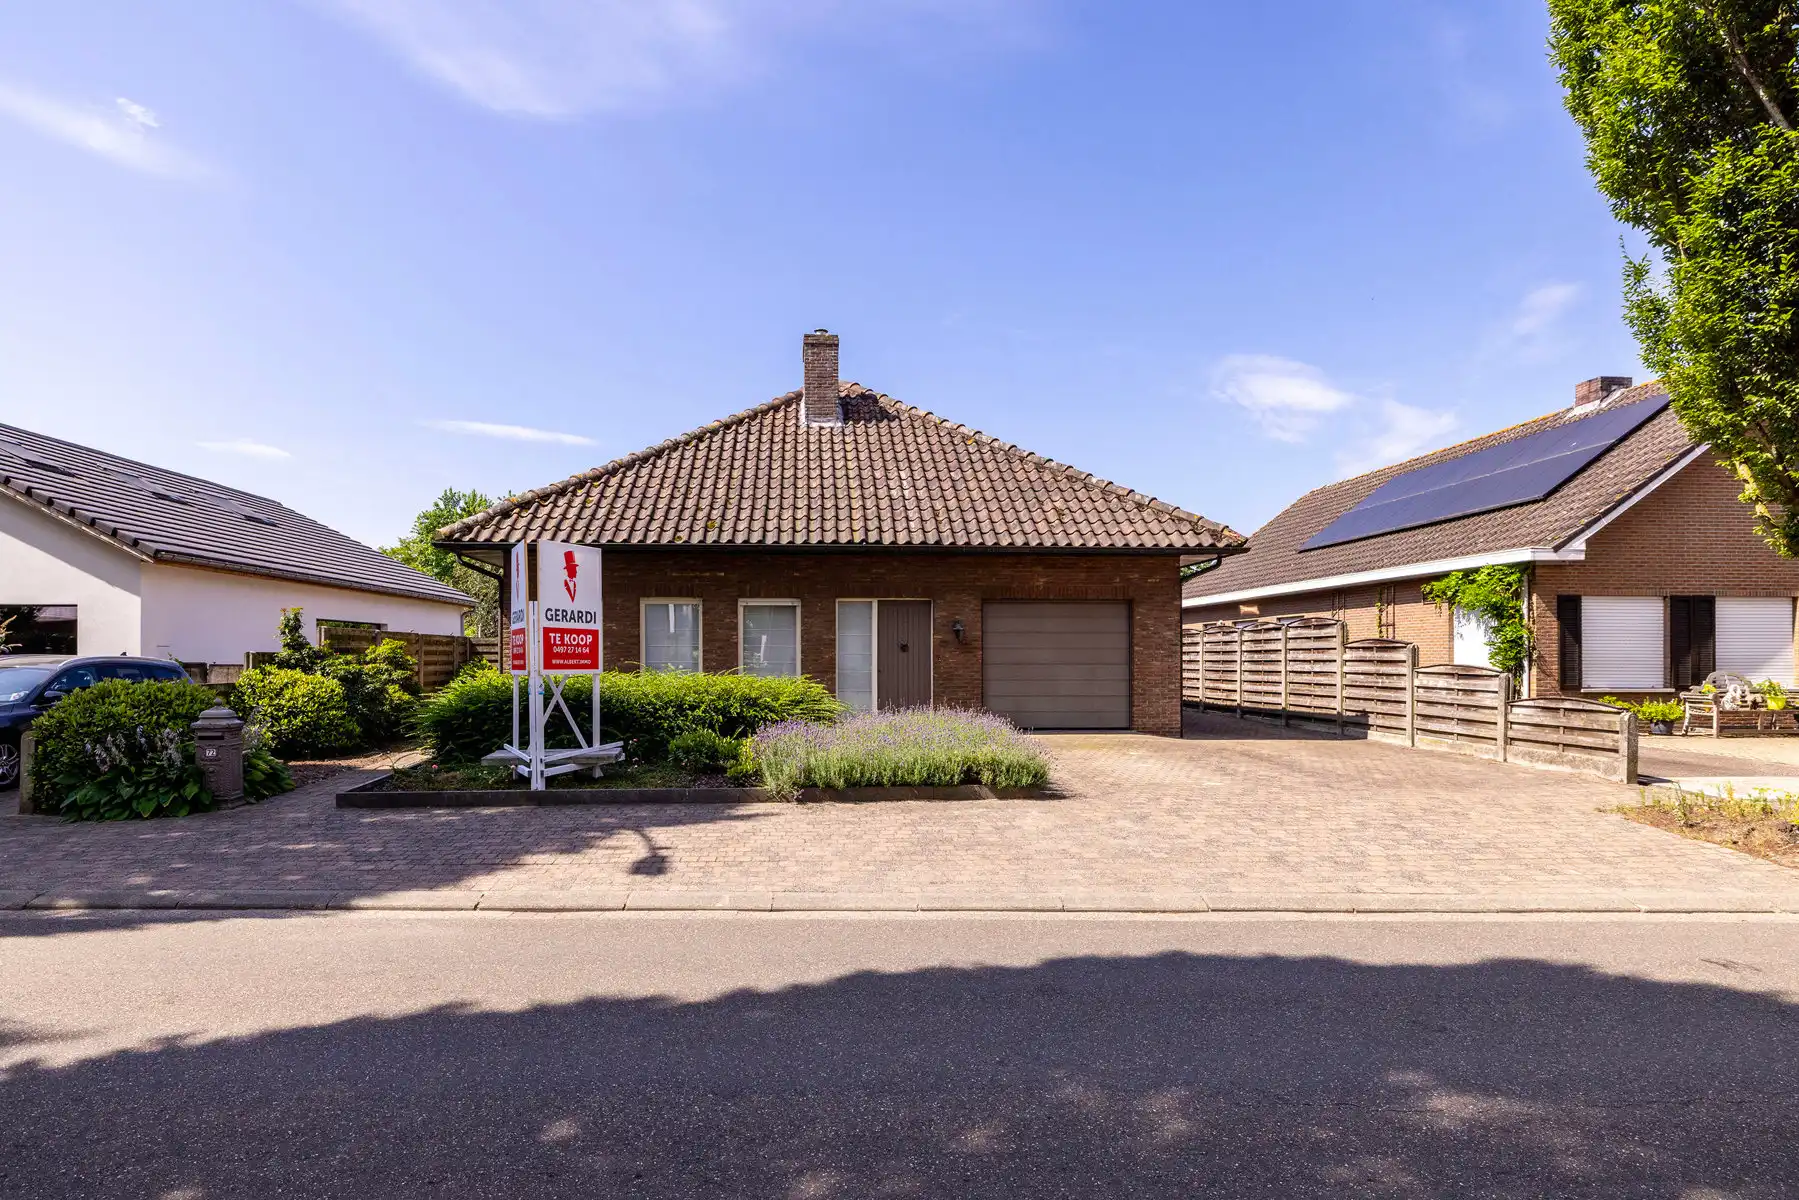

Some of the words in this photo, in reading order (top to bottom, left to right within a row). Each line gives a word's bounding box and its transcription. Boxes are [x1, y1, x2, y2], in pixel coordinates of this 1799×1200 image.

[545, 608, 596, 624] GERARDI
[549, 633, 561, 644] TE
[564, 633, 592, 645] KOOP
